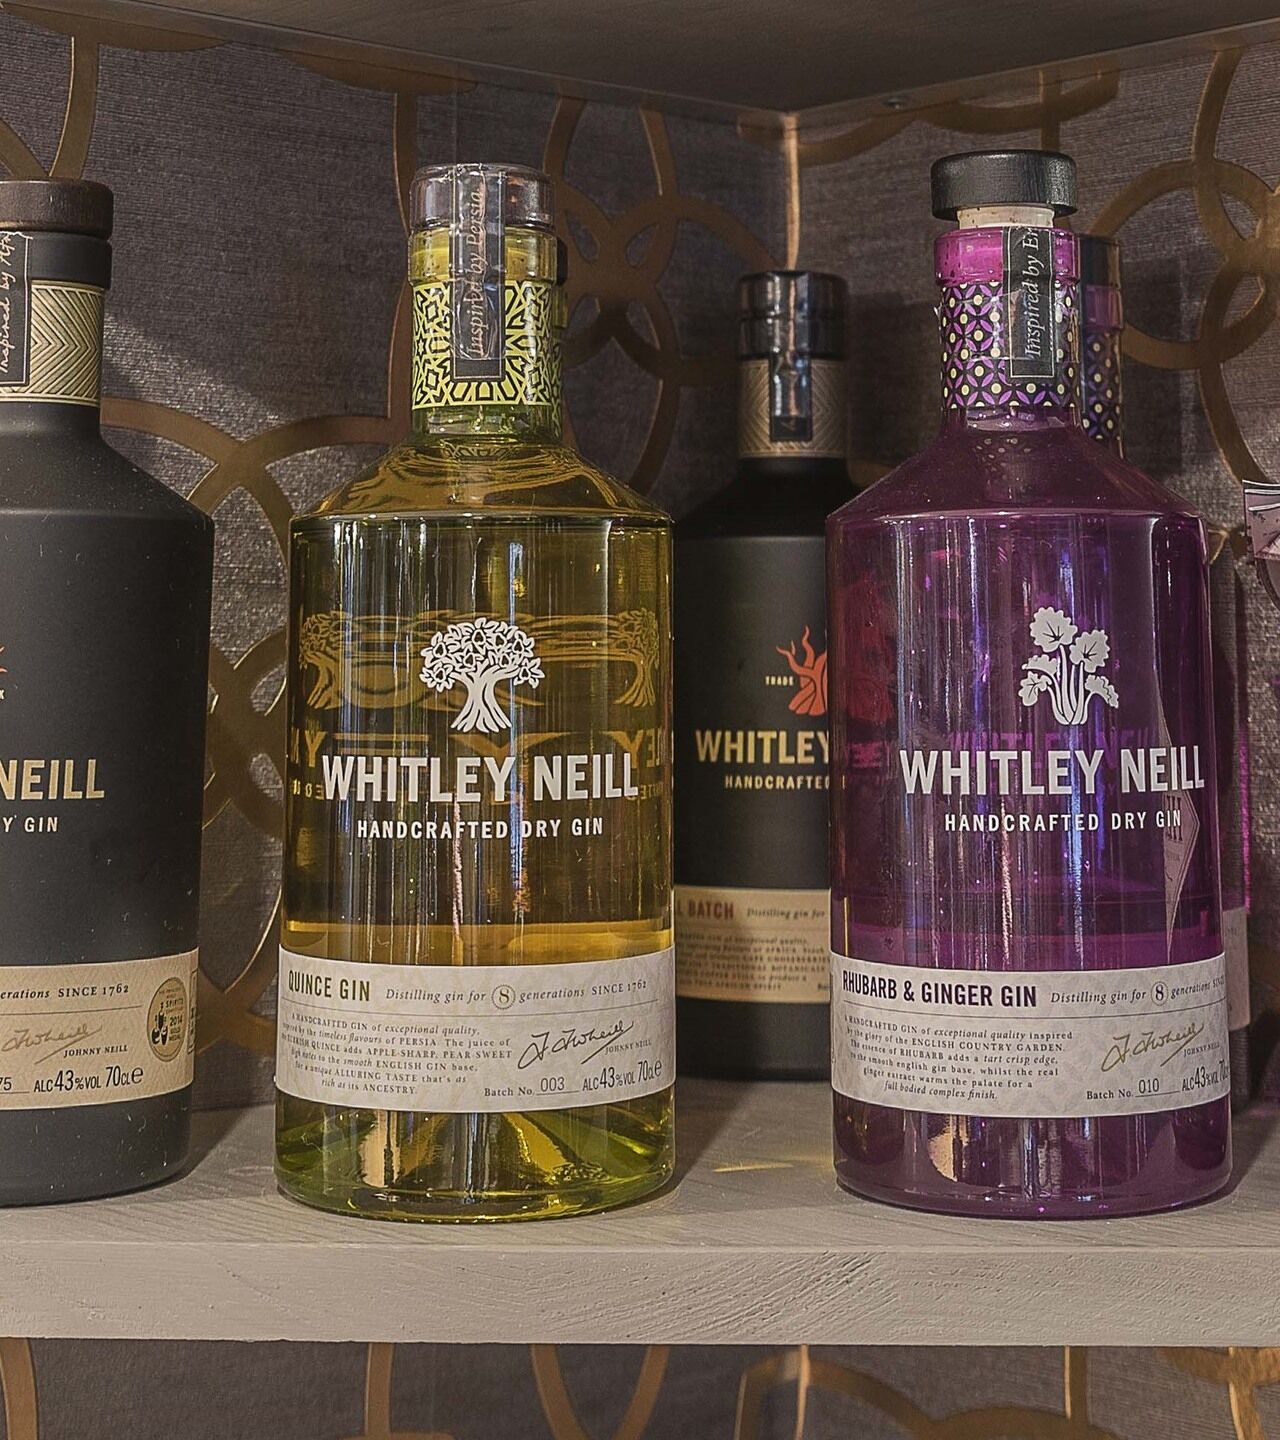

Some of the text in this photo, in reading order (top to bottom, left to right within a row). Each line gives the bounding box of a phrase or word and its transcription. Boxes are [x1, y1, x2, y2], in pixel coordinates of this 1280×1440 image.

[321, 752, 639, 803] WHITLEY NEILL
[899, 744, 1205, 795] WHITLEY NEILL
[24, 815, 59, 833] GIN
[357, 817, 604, 840] HANDCRAFTED DRY GIN
[944, 809, 1182, 832] HANDCRAFTED DRY GIN
[57, 985, 98, 999] SINCE
[101, 983, 130, 998] 1762
[288, 969, 371, 1002] QUINCE GIN
[842, 970, 1037, 1008] RHUBARB & GINGER GIN
